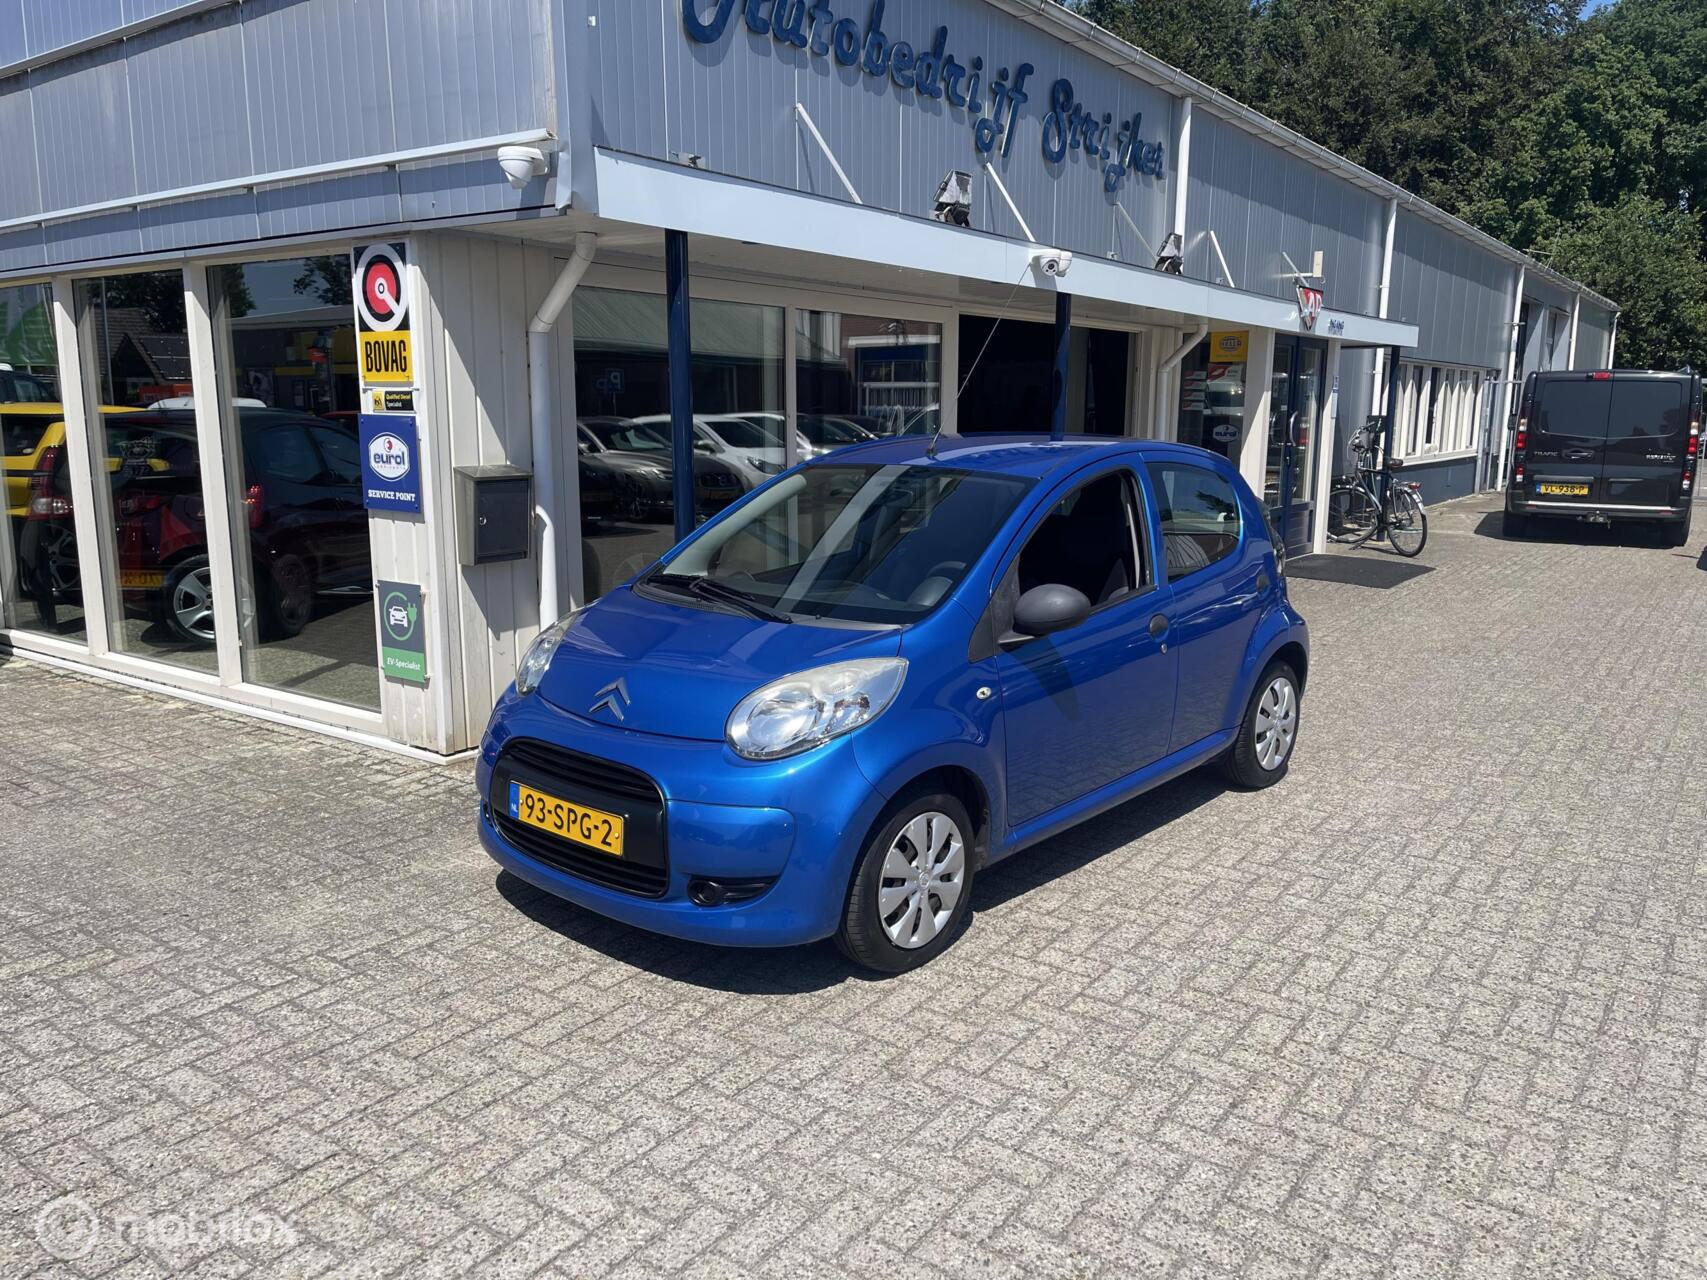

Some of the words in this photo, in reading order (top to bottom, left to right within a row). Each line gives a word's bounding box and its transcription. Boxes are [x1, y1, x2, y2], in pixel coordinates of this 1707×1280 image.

[1042, 78, 1163, 192] Strijker
[365, 340, 407, 373] BOVAG
[373, 452, 405, 466] eurol
[367, 489, 395, 500] SERVICE
[395, 491, 416, 502] POINT
[387, 656, 421, 671] EV-Specialist
[525, 793, 612, 847] 93-SPG-2
